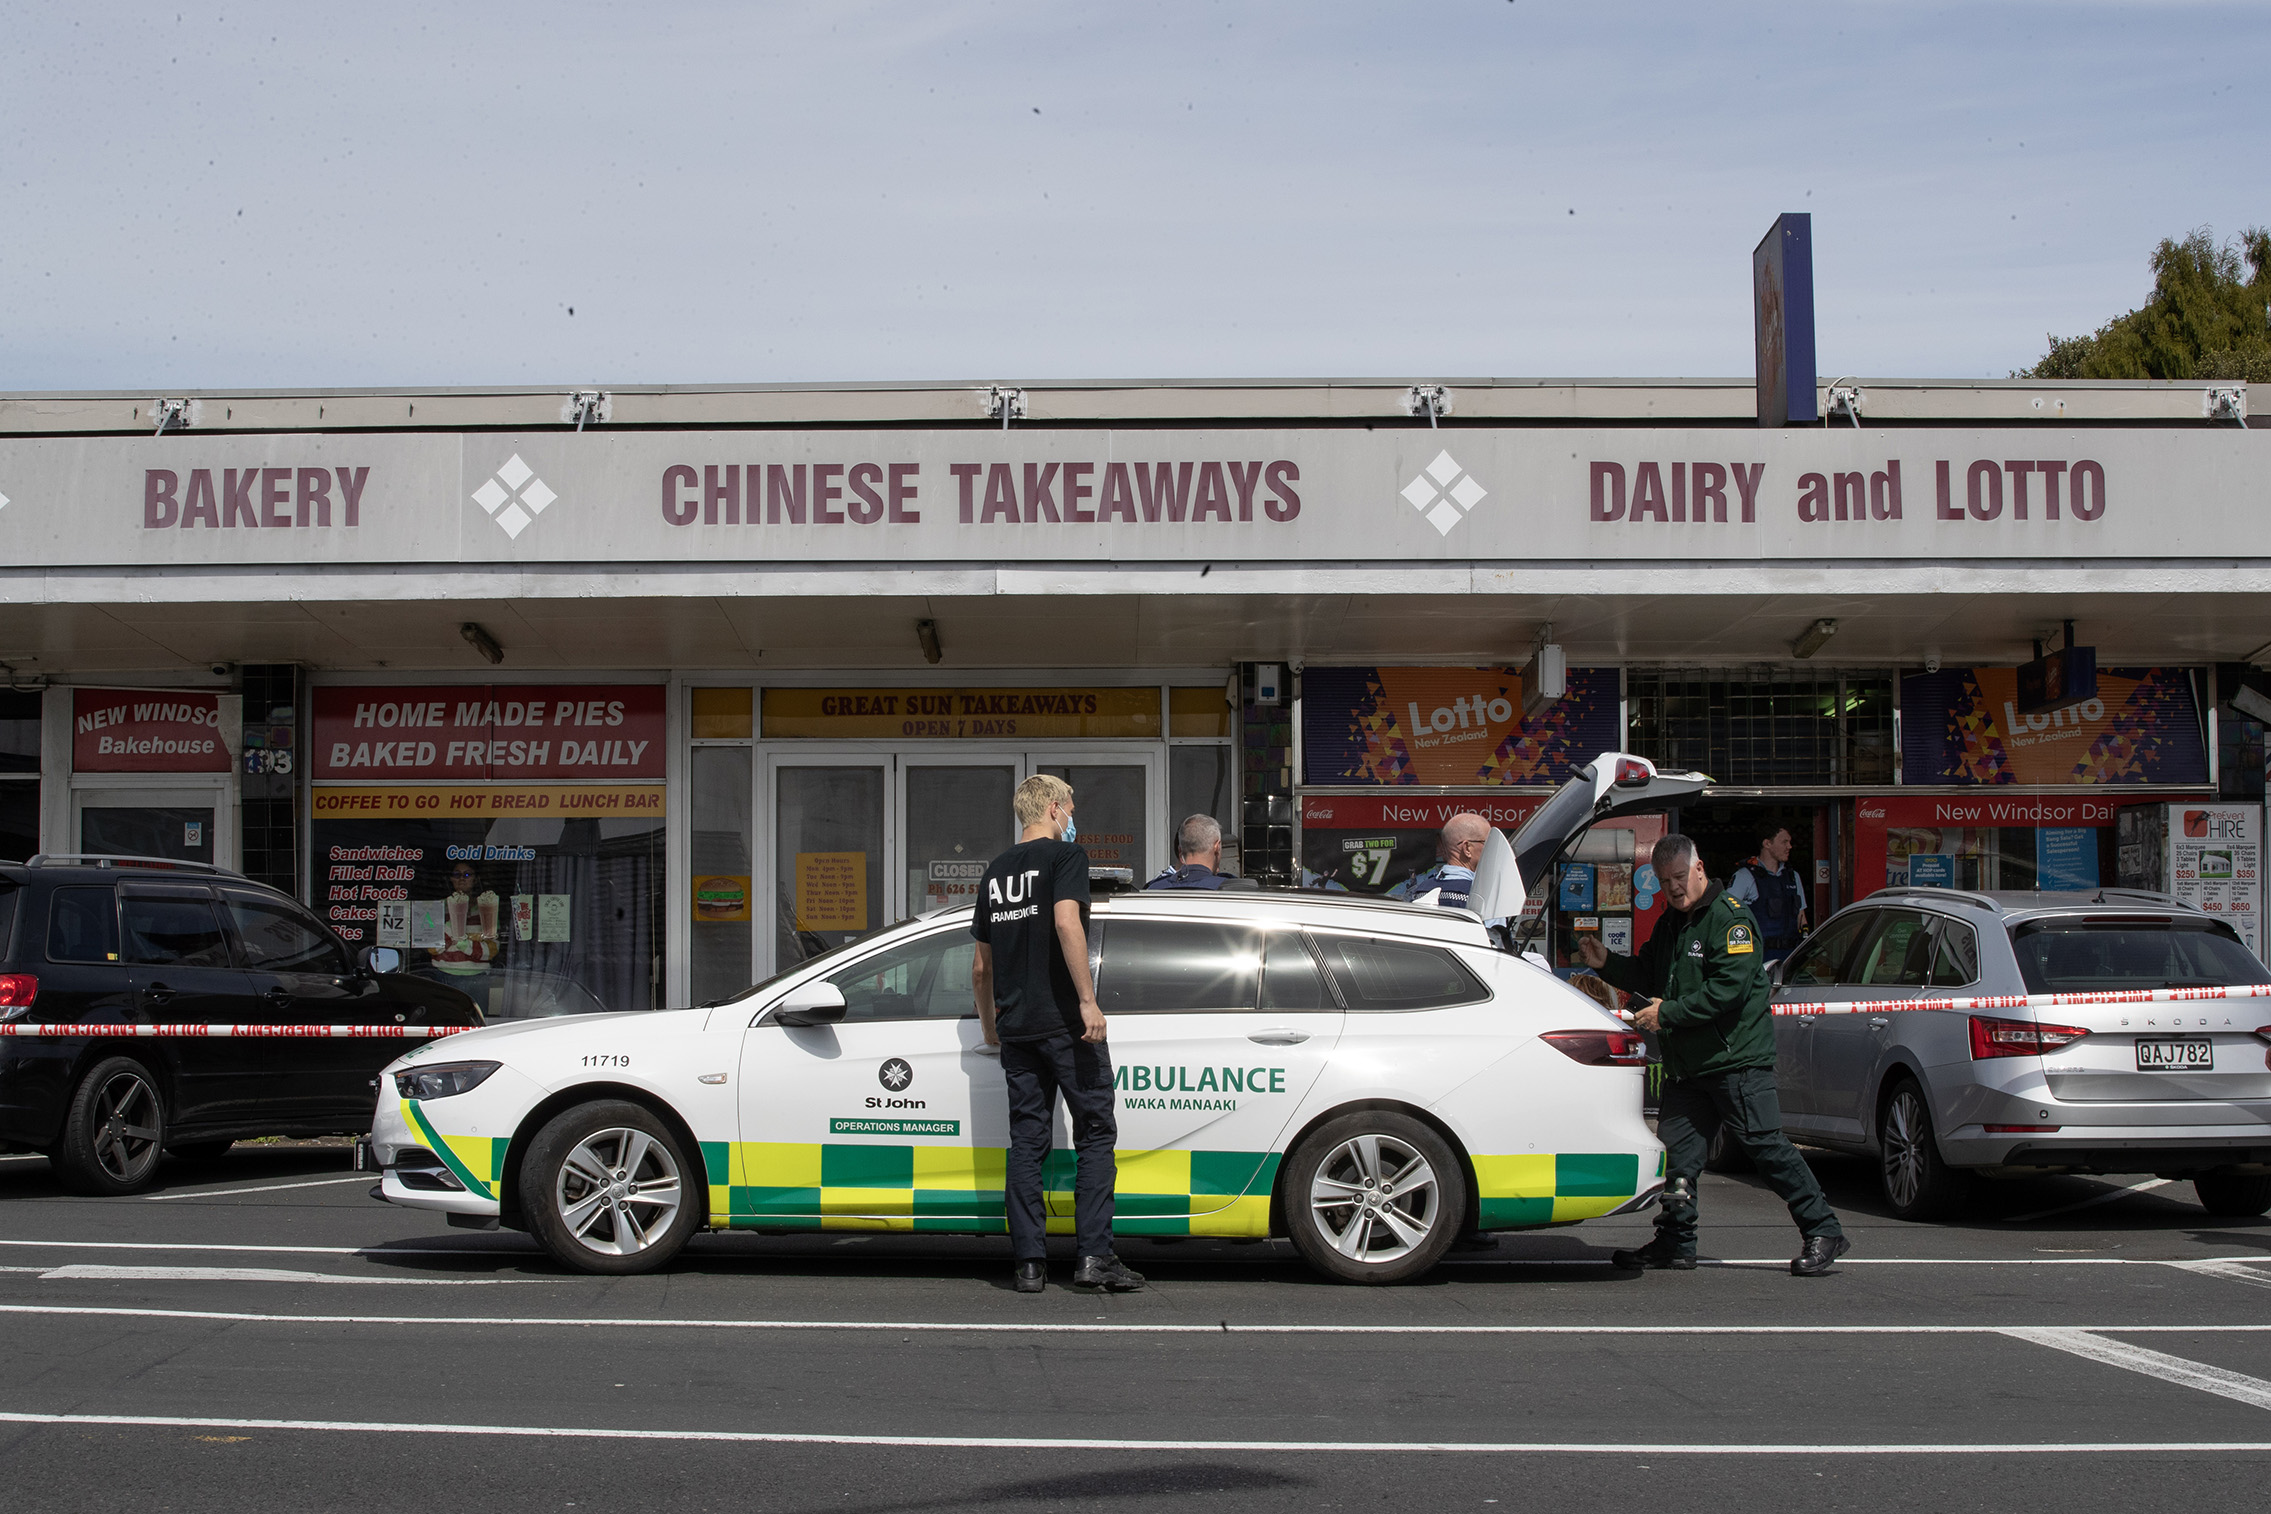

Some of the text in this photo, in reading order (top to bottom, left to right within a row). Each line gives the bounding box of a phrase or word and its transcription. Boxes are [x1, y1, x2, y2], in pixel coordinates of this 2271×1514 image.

[143, 466, 371, 529] BAKERY
[661, 459, 1300, 526] CHINESE TAKEAWAYS
[1590, 459, 2106, 523] DAIRY and LOTTO
[822, 694, 1097, 715] GREAT SUN TAKEAWAYS
[77, 703, 218, 734] NEW WINDSO
[353, 701, 625, 727] HOME MADE PIES
[1408, 694, 1512, 736] Lotto
[902, 719, 1016, 736] OPEN 7 DAYS
[98, 736, 214, 754] Bakehouse
[1414, 728, 1488, 750] New Zealand
[2011, 726, 2082, 748] New Zealand
[329, 740, 649, 767] BAKED FRESH DAILY
[316, 794, 660, 810] COFFEE TO GO HOT BREAD LUNCH BAR
[1383, 805, 1429, 821] New
[1936, 803, 2115, 820] New Windsor Dai
[2209, 811, 2245, 819] PreEvent
[2210, 821, 2245, 838] HIRE
[1104, 834, 1134, 844] FOOD
[1345, 841, 1363, 849] GRAB
[1365, 840, 1379, 848] TWO
[330, 846, 423, 861] Sandwiches
[446, 845, 536, 861] Cold Drinks
[329, 866, 415, 881] Filled Rolls
[934, 864, 984, 877] CLOSED
[1352, 849, 1391, 886] $7
[2176, 869, 2195, 878] $250
[2237, 869, 2255, 878] $350
[1641, 869, 1654, 890] 2
[329, 886, 408, 901] Hot Foods
[928, 884, 965, 894] Ph 626
[989, 869, 1040, 908] AUT
[330, 906, 377, 920] Cakes
[383, 905, 391, 917] I
[2203, 902, 2222, 911] $450
[2231, 902, 2250, 911] $650
[383, 918, 404, 930] NZ
[330, 926, 363, 940] Pies
[581, 1055, 630, 1067] 11719
[2140, 1045, 2208, 1063] QAJ782
[1113, 1066, 1285, 1093] MBULANCE
[865, 1097, 926, 1109] St John
[1124, 1098, 1236, 1111] WAKA MANAAKI
[835, 1122, 954, 1132] OPERATIONS MANAGER
